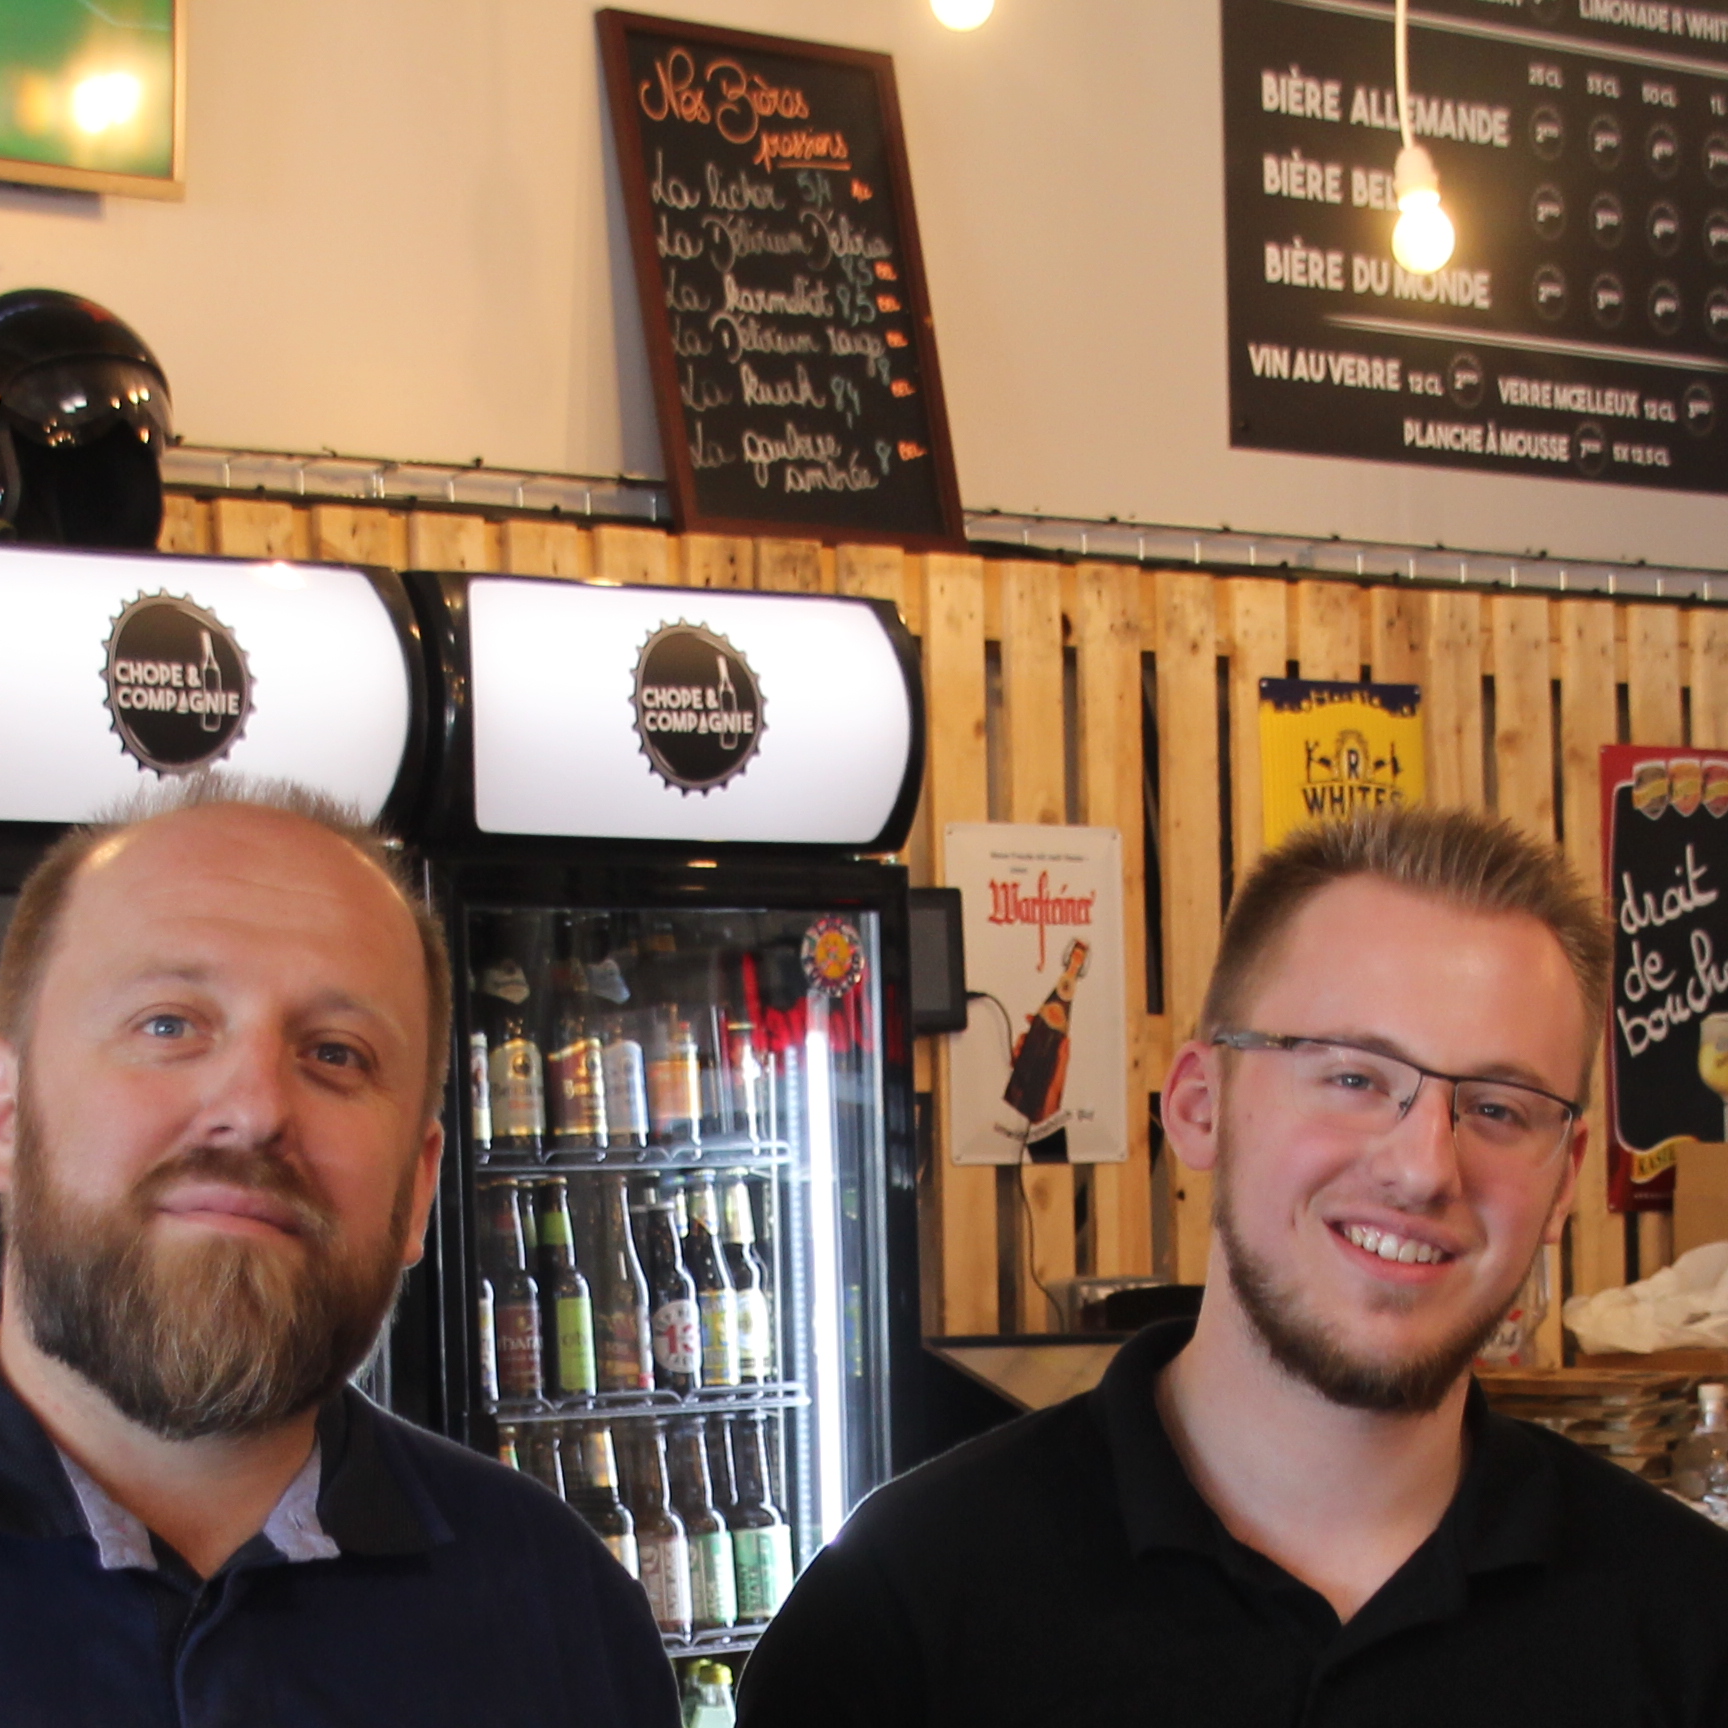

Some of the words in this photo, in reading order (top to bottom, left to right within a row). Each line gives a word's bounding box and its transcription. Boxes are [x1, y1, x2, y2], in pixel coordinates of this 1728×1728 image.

[1579, 0, 1670, 34] LIMONADE
[1671, 10, 1684, 36] R
[640, 46, 711, 124] Nos
[705, 58, 810, 144] Bières
[1262, 63, 1342, 122] BIÈRE
[1350, 84, 1511, 147] ALLEMANDE
[651, 145, 700, 211] La
[1263, 147, 1342, 204] BIÈRE
[657, 213, 704, 259] La
[665, 267, 710, 312] La
[1264, 235, 1345, 291] BIÈRE
[1352, 254, 1390, 296] DU
[1393, 263, 1492, 310] MONDE
[680, 364, 732, 412] La
[1248, 343, 1290, 380] VIN
[1292, 350, 1326, 382] AU
[1327, 353, 1401, 392] VERRE
[1498, 376, 1553, 409] VERRE
[690, 420, 736, 470] La
[1403, 416, 1484, 454] PLANCHE
[1500, 428, 1572, 463] MOUSSE
[115, 660, 184, 687] CHOPE
[186, 664, 202, 688] &
[117, 687, 240, 716] COMPAGNIE
[642, 687, 703, 710] CHOPE
[705, 687, 719, 710] &
[645, 710, 754, 734] COMPAGNIE
[1348, 750, 1359, 779] R
[1621, 843, 1718, 934] droit
[1625, 940, 1676, 1001] de
